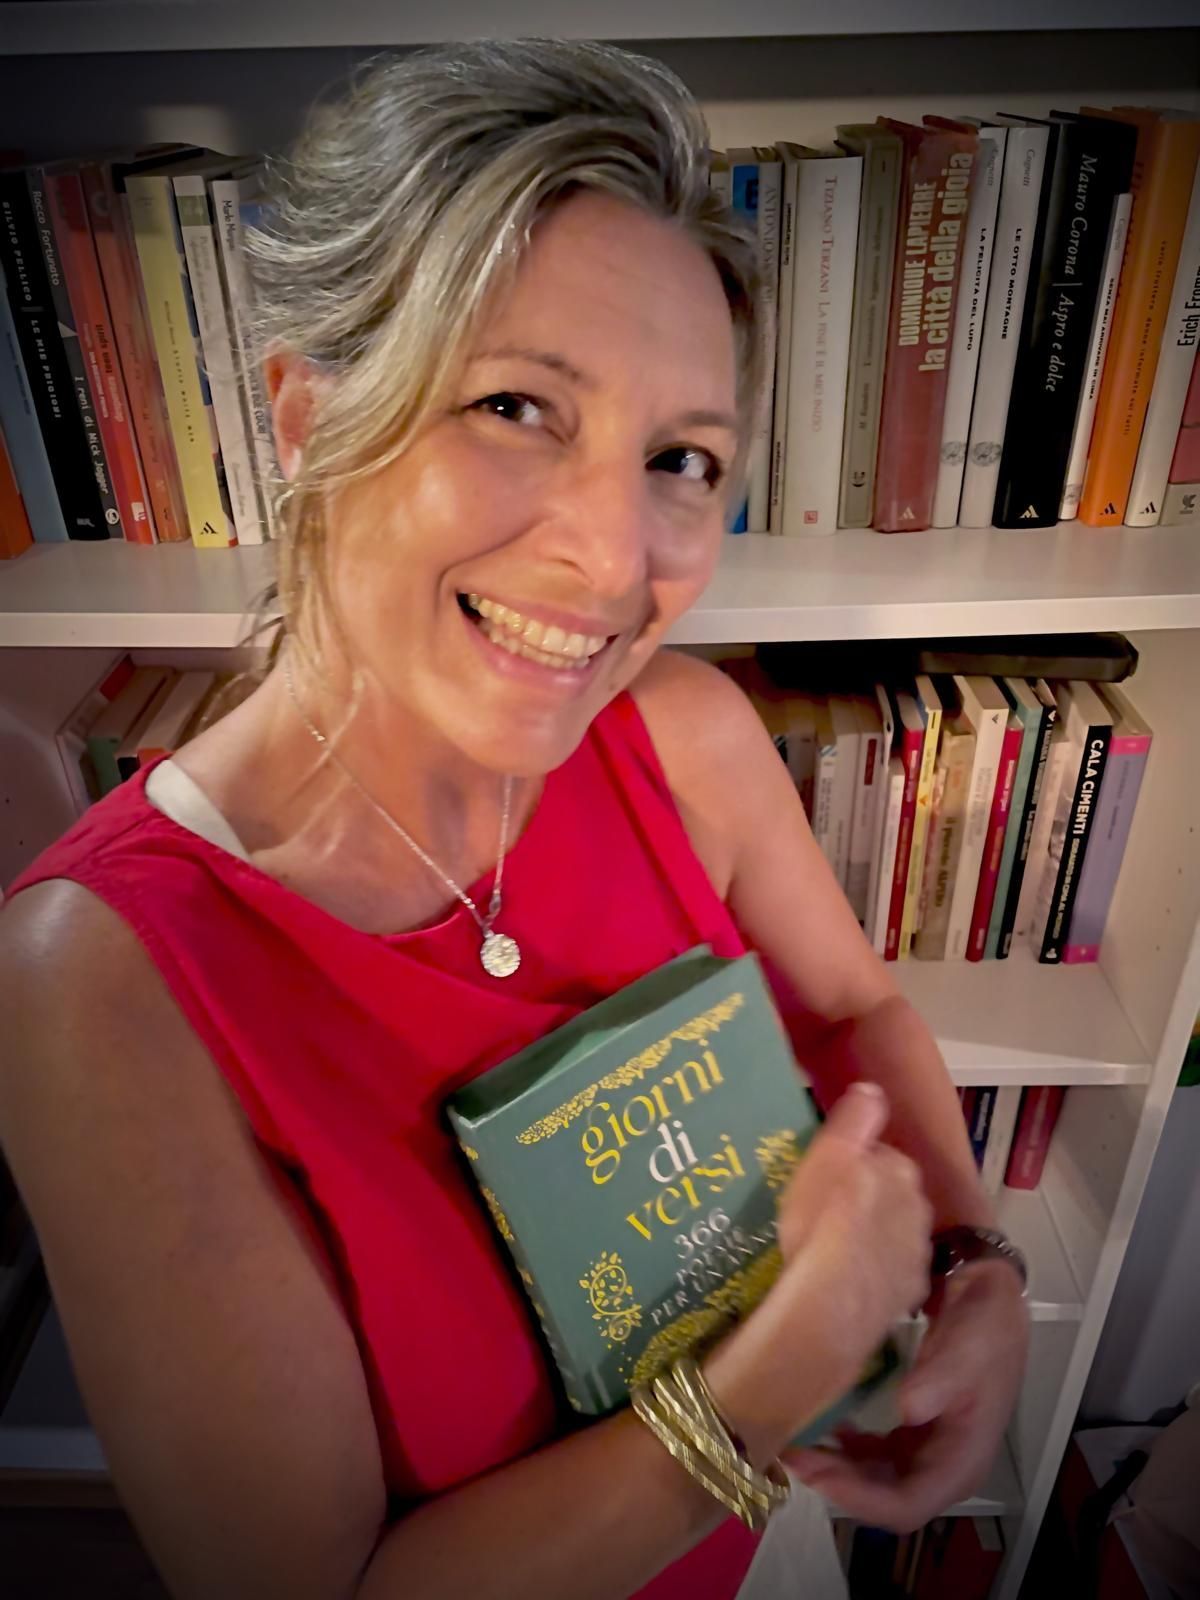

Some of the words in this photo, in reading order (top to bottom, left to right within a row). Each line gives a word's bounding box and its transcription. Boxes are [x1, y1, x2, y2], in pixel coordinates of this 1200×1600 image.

[823, 176, 838, 233] TIZIANO
[937, 153, 974, 216] gioia
[1074, 154, 1098, 211] Mauro
[33, 191, 45, 224] Rocco
[41, 229, 60, 286] Fortunato
[906, 181, 937, 255] LAPIERRE
[979, 228, 987, 242] LA
[1015, 228, 1022, 241] LE
[2, 202, 18, 245] SILVIO
[14, 250, 32, 301] PELLICO
[819, 236, 835, 293] TERZANI
[927, 220, 960, 282] della
[1009, 246, 1021, 276] OTTO
[1065, 217, 1088, 275] Corona
[898, 259, 926, 345] DOMINIQUE
[970, 299, 978, 319] DEL
[1001, 279, 1014, 340] MONTAGNE
[1106, 278, 1114, 306] SENZA
[1184, 265, 1200, 310] Fro
[922, 286, 953, 344] città
[966, 322, 975, 350] LUPO
[1053, 294, 1075, 337] Aspro
[1177, 313, 1200, 347] Erich
[31, 320, 40, 333] LE
[36, 339, 47, 360] MIE
[918, 349, 946, 371] la
[1052, 342, 1062, 350] e
[1095, 327, 1106, 366] ARRIVARE
[1045, 355, 1066, 393] dolce
[1088, 380, 1096, 400] CIMA
[78, 387, 91, 409] reni
[84, 416, 95, 427] di
[1083, 738, 1104, 778] CALA
[1072, 780, 1095, 835] CIMENTI
[582, 1039, 723, 1184] giorni
[650, 1120, 698, 1183] di
[626, 1133, 746, 1240] versi
[675, 1207, 731, 1259] 366
